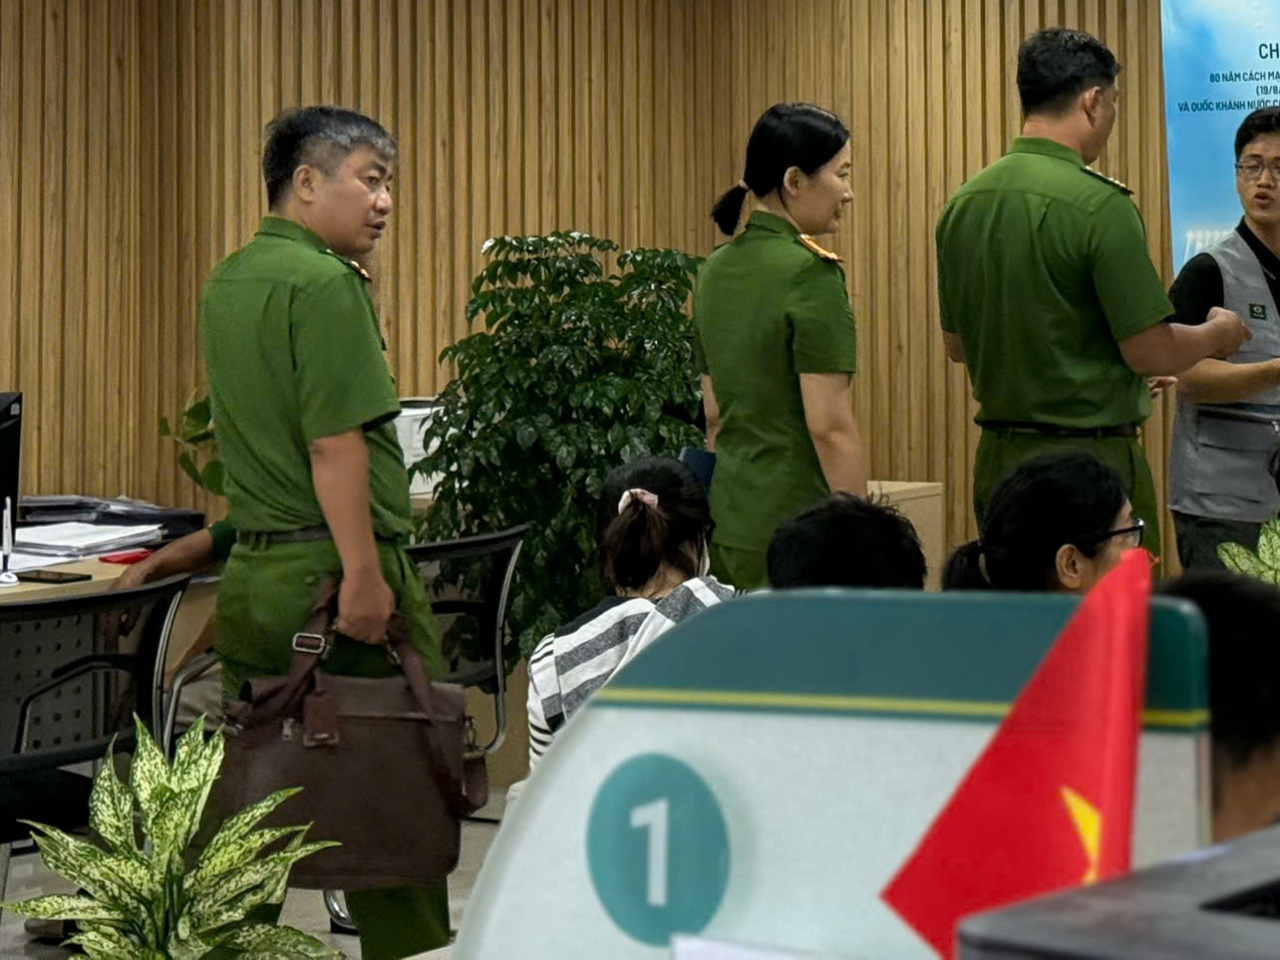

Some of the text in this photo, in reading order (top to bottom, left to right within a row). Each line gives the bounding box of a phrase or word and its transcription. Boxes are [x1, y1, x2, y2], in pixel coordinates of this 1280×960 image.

[1209, 73, 1220, 83] 80
[1242, 70, 1266, 82] CÁCH
[1178, 100, 1190, 112] VÀ
[1191, 99, 1214, 112] QUỐC
[1216, 100, 1246, 111] KHÁNH
[628, 797, 671, 908] 1
